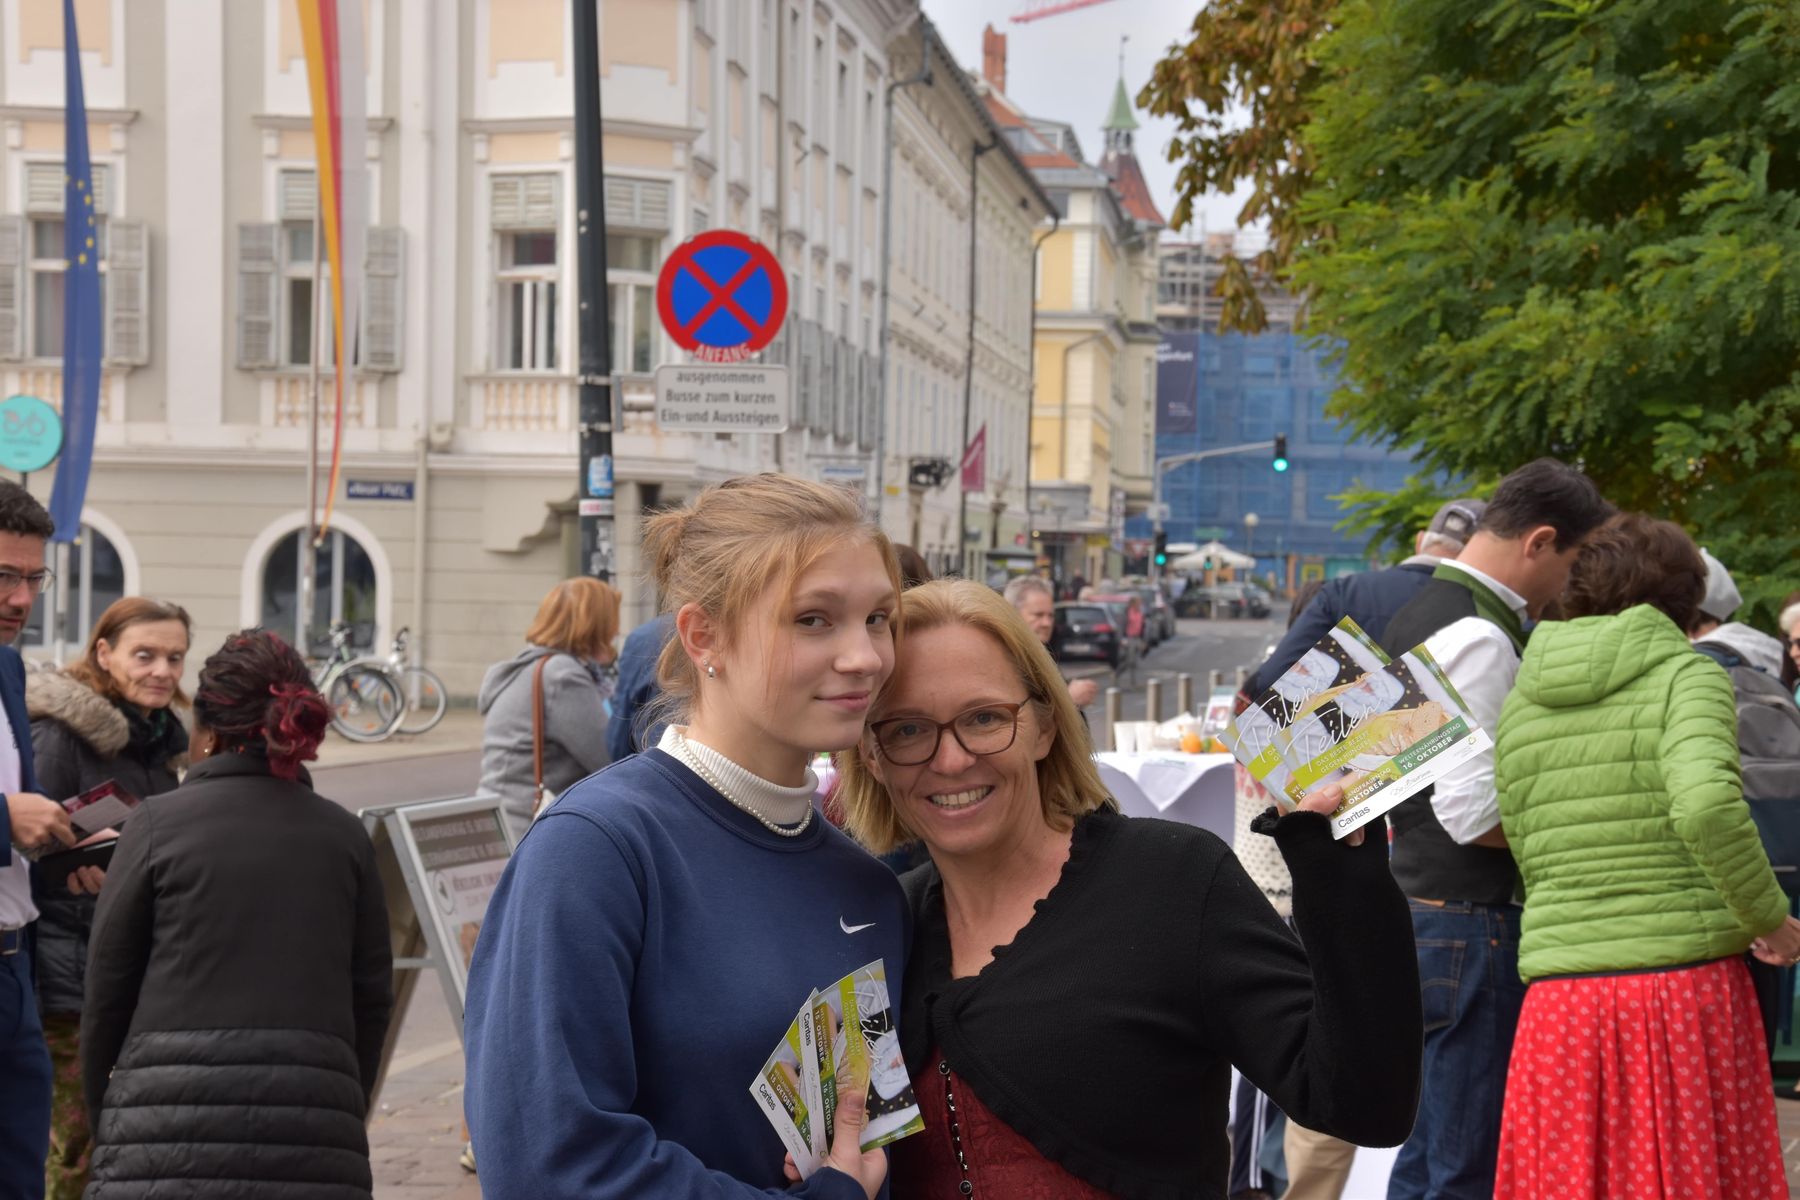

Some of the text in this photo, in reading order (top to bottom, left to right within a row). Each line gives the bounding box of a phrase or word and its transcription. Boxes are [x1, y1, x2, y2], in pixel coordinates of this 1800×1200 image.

[695, 342, 750, 363] ANFANG
[676, 371, 765, 385] ausgenommen
[665, 388, 776, 404] Busse zum kurzen
[712, 409, 780, 427] Aussteigen
[1234, 680, 1319, 763] Teilen
[1284, 698, 1382, 773] Teilen
[1417, 736, 1453, 762] OKTOBER
[1349, 780, 1384, 805] OKTOBER
[1338, 805, 1371, 829] Caritas
[803, 1012, 812, 1047] Caritas
[848, 969, 891, 1075] Teilen
[817, 1024, 826, 1063] OKTOBER
[759, 1083, 776, 1111] Caritas
[776, 1085, 795, 1113] OKTOBER
